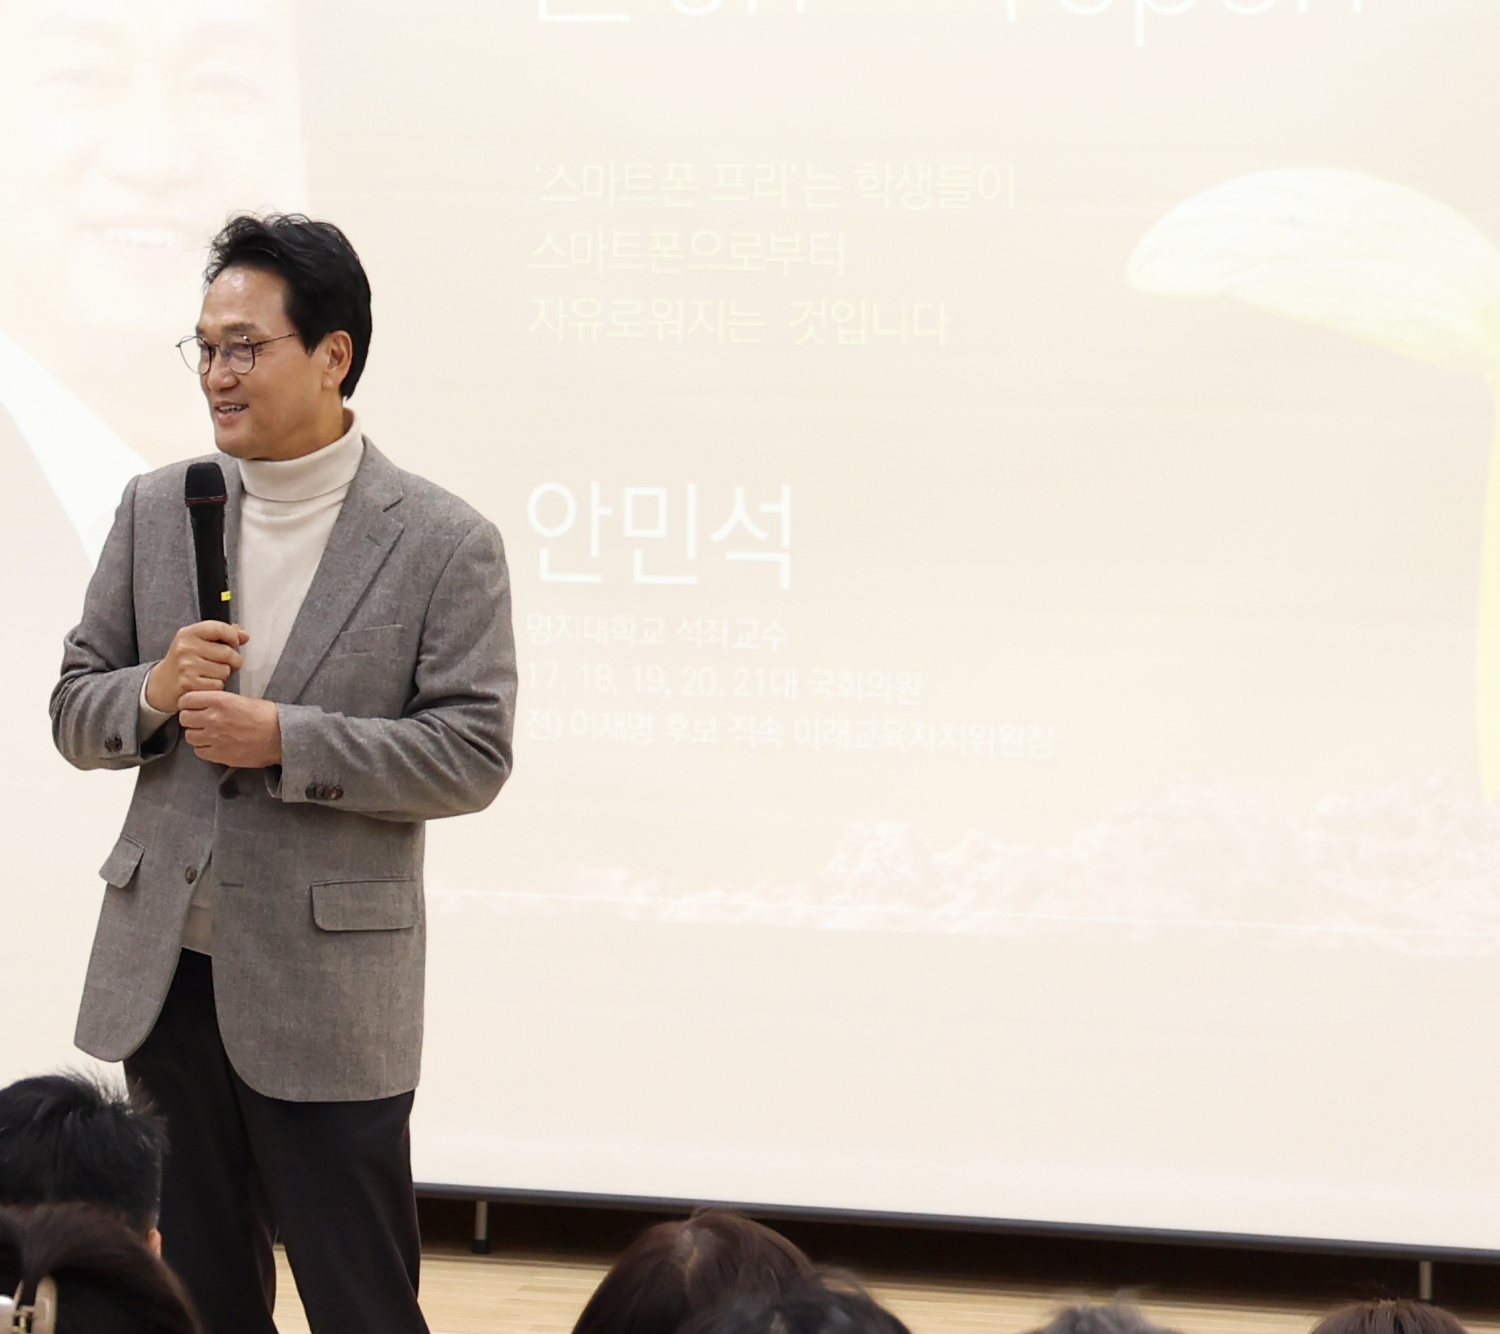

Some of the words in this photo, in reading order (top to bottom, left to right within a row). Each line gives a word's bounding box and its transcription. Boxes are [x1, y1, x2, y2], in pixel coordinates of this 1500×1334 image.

[855, 161, 1017, 210] 학생들이
[529, 230, 847, 277] 스마트폰으로부터
[529, 297, 766, 346] 자유로워지는
[788, 300, 951, 347] 것입니다
[527, 480, 792, 590] 안민석
[806, 668, 924, 706] 국회의원
[663, 712, 720, 744] 후보
